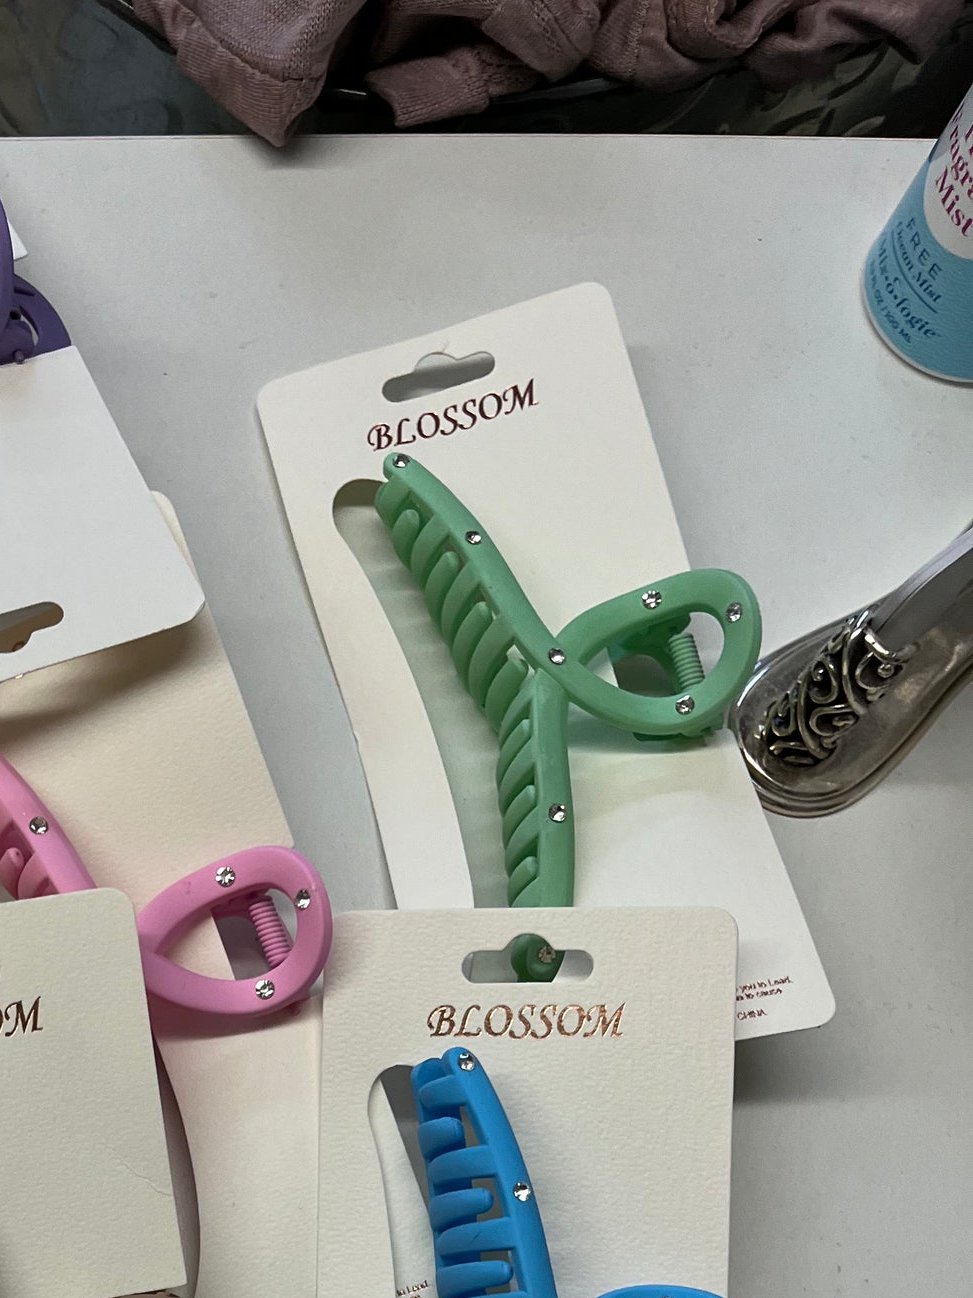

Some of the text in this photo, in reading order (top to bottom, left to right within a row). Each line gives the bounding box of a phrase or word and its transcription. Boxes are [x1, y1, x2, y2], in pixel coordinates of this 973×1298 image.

[907, 217, 943, 281] FREE
[367, 378, 539, 451] BLOSSOM
[427, 1002, 626, 1039] BLOSSOM
